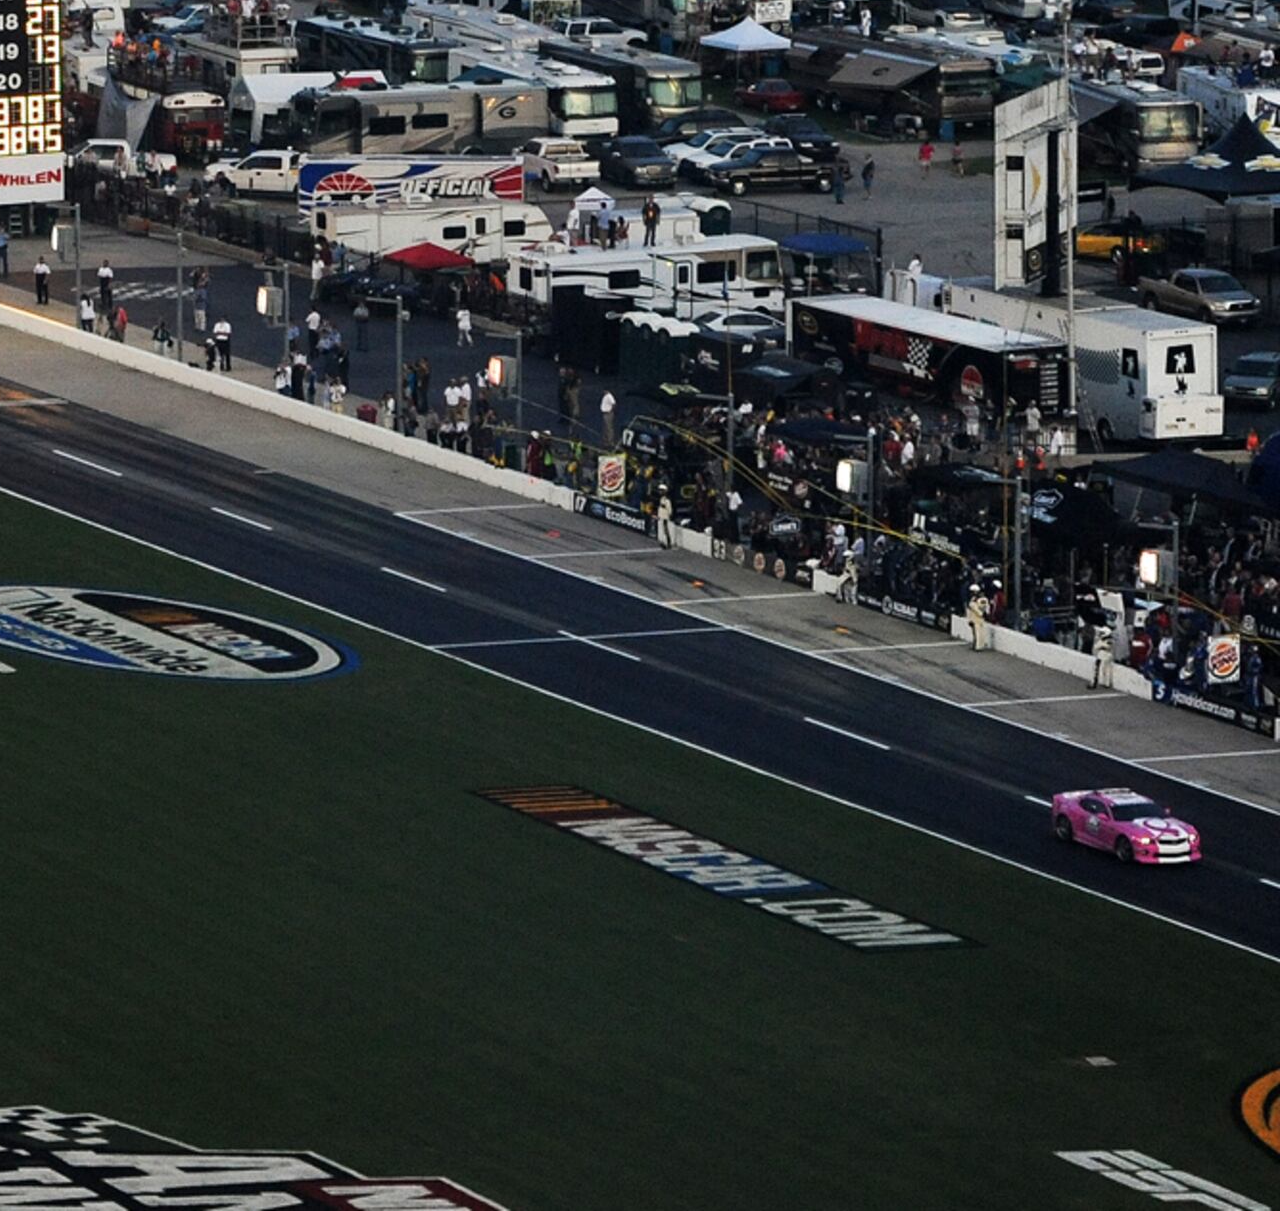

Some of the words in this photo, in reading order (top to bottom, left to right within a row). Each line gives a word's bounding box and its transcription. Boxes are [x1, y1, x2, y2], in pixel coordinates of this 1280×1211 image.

[26, 5, 59, 35] 27
[36, 35, 60, 63] 13
[400, 178, 492, 197] OFFICIAL
[622, 428, 635, 446] 17
[575, 496, 587, 512] 17
[605, 507, 646, 530] EcoBoost
[10, 600, 209, 674] Nationwide
[1155, 682, 1166, 700] 5
